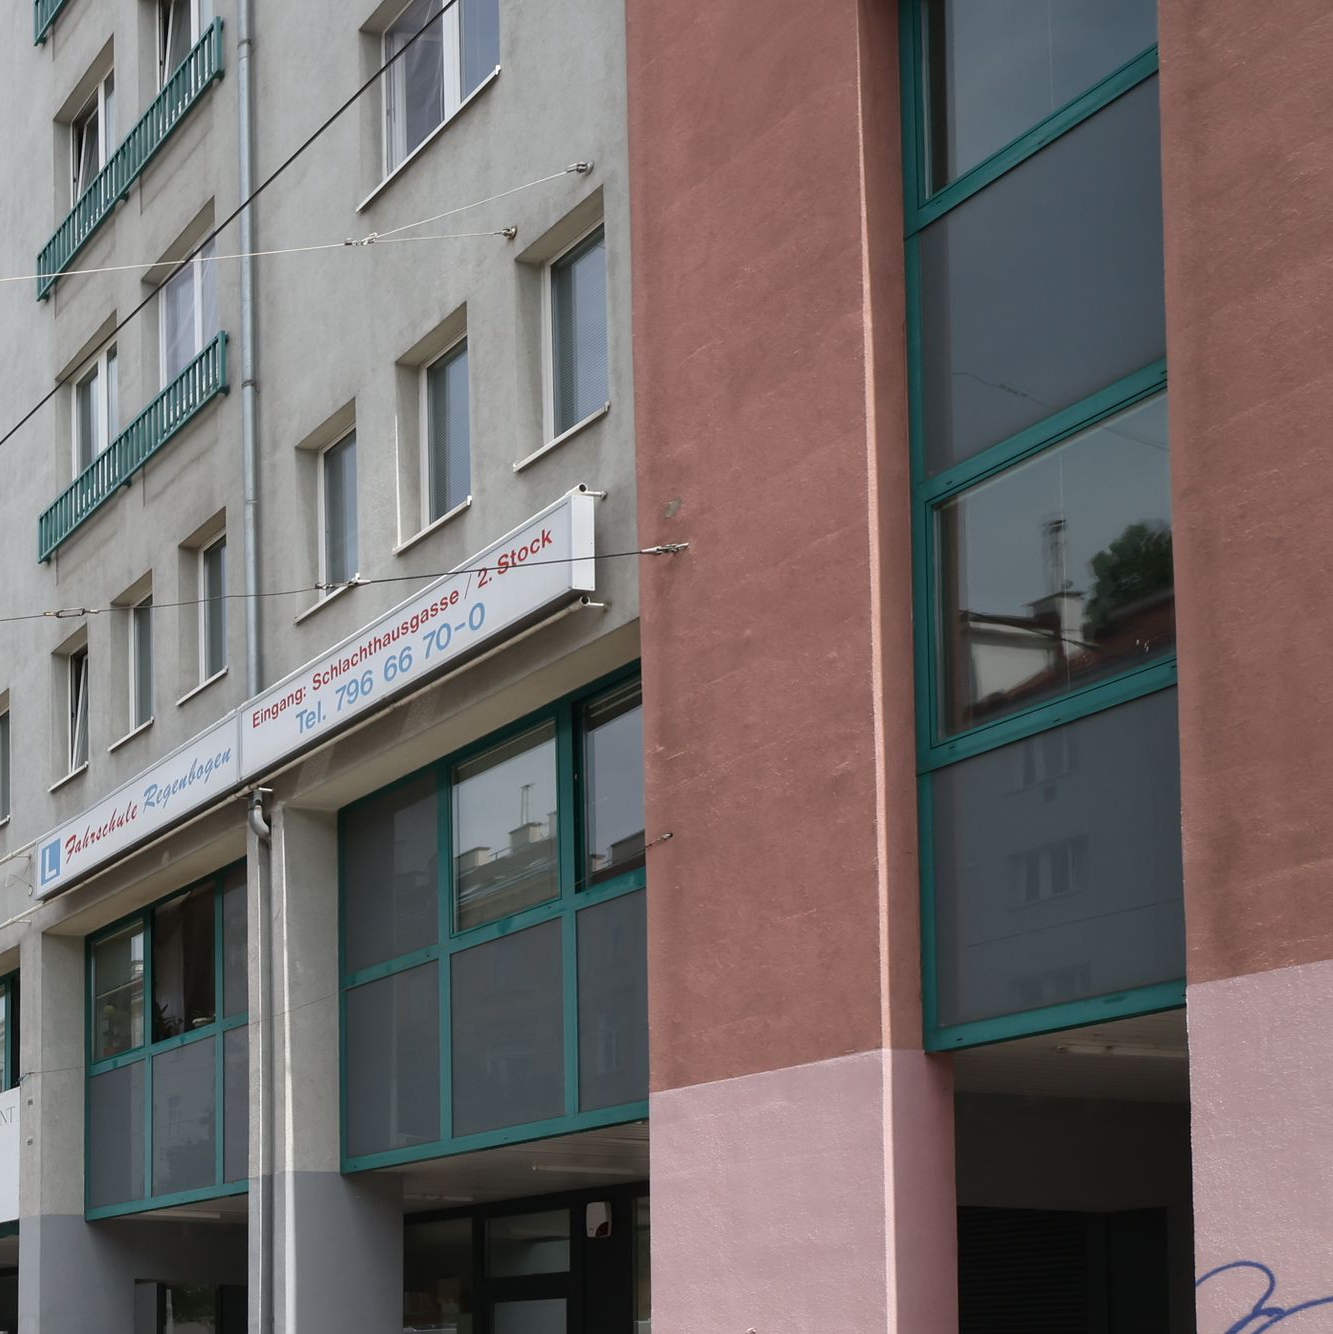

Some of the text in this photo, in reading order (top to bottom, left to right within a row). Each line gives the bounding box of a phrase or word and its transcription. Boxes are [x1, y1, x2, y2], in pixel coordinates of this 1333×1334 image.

[252, 686, 307, 729] Eingang:
[312, 588, 460, 691] Schlachthausgasse
[477, 567, 493, 589] 2.
[497, 528, 553, 575] Stock
[295, 602, 486, 735] Tel. 796 66 70-0
[45, 748, 231, 878] L Fahrschule Regenbogen
